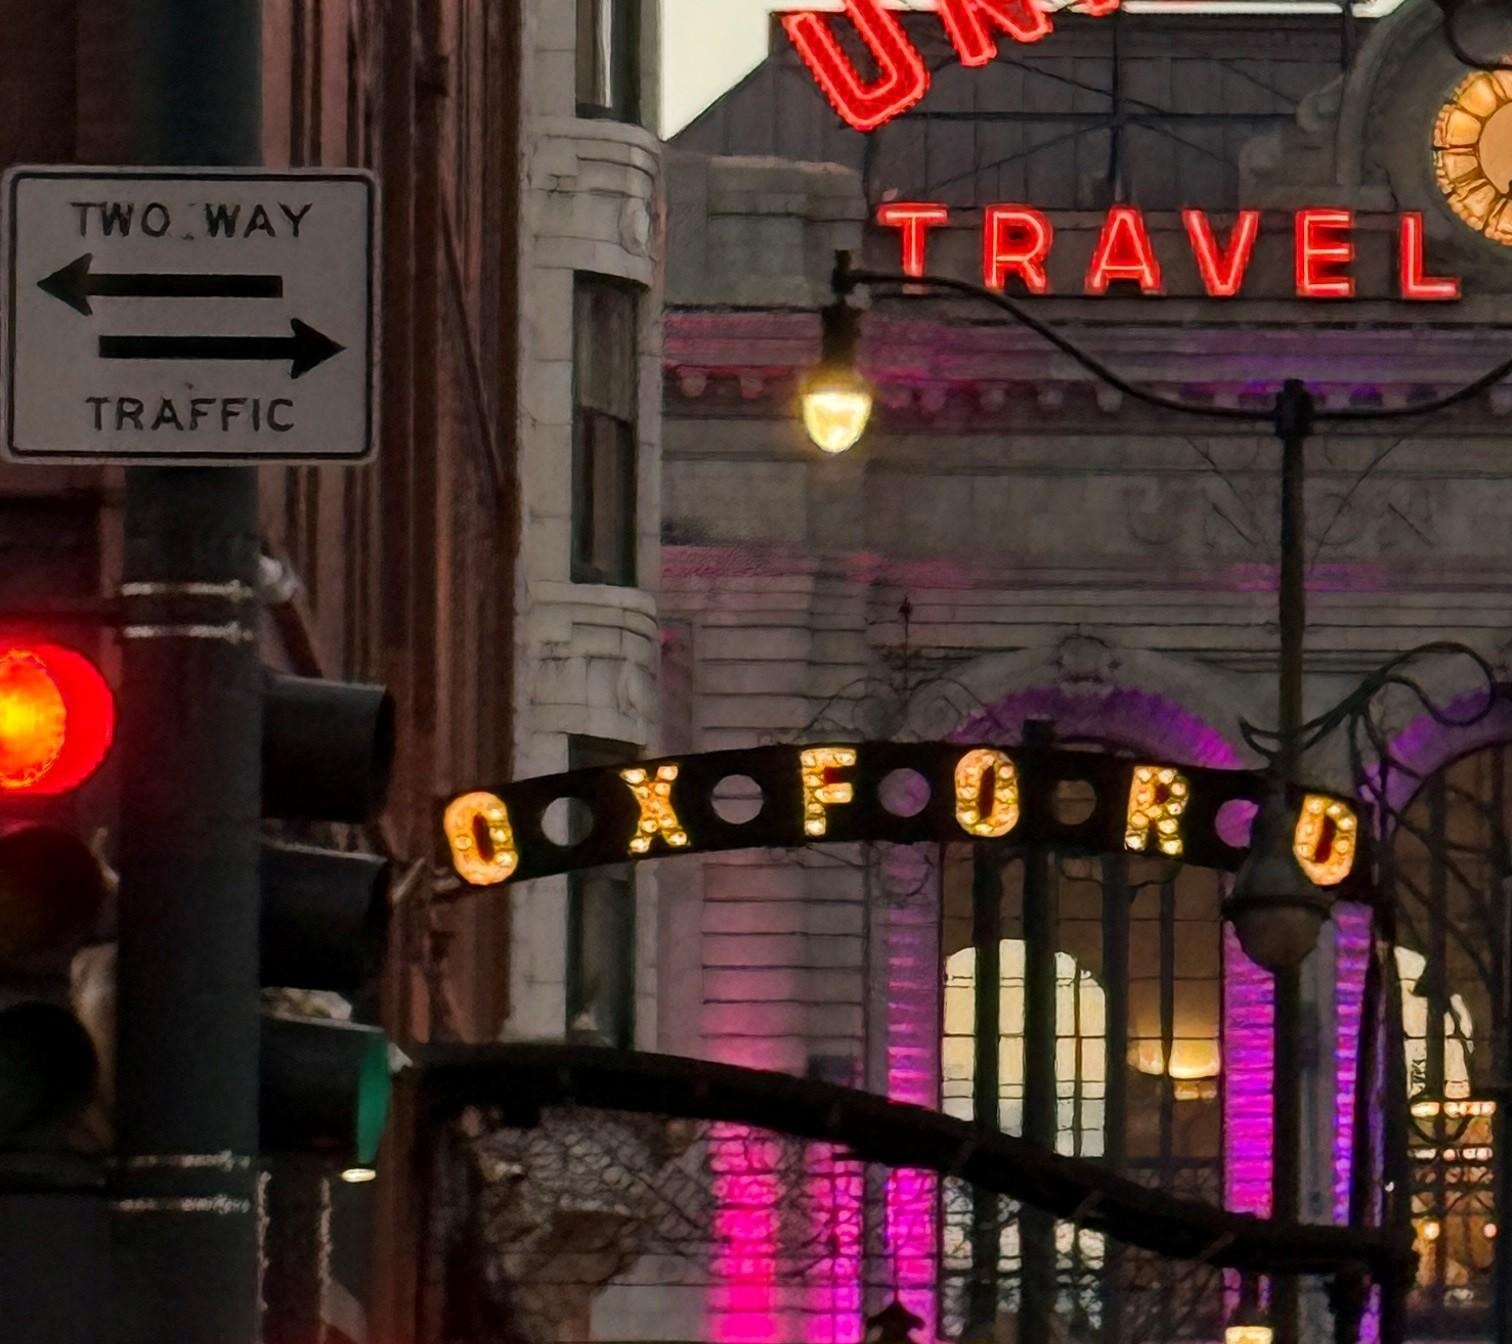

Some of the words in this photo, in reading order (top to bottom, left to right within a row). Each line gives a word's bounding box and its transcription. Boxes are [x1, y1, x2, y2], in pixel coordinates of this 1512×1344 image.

[71, 202, 171, 237] TWO
[205, 202, 312, 238] WAY
[876, 202, 1461, 299] TRAVEL
[85, 396, 295, 433] TRAFFIC
[442, 746, 1358, 887] OXFORD
